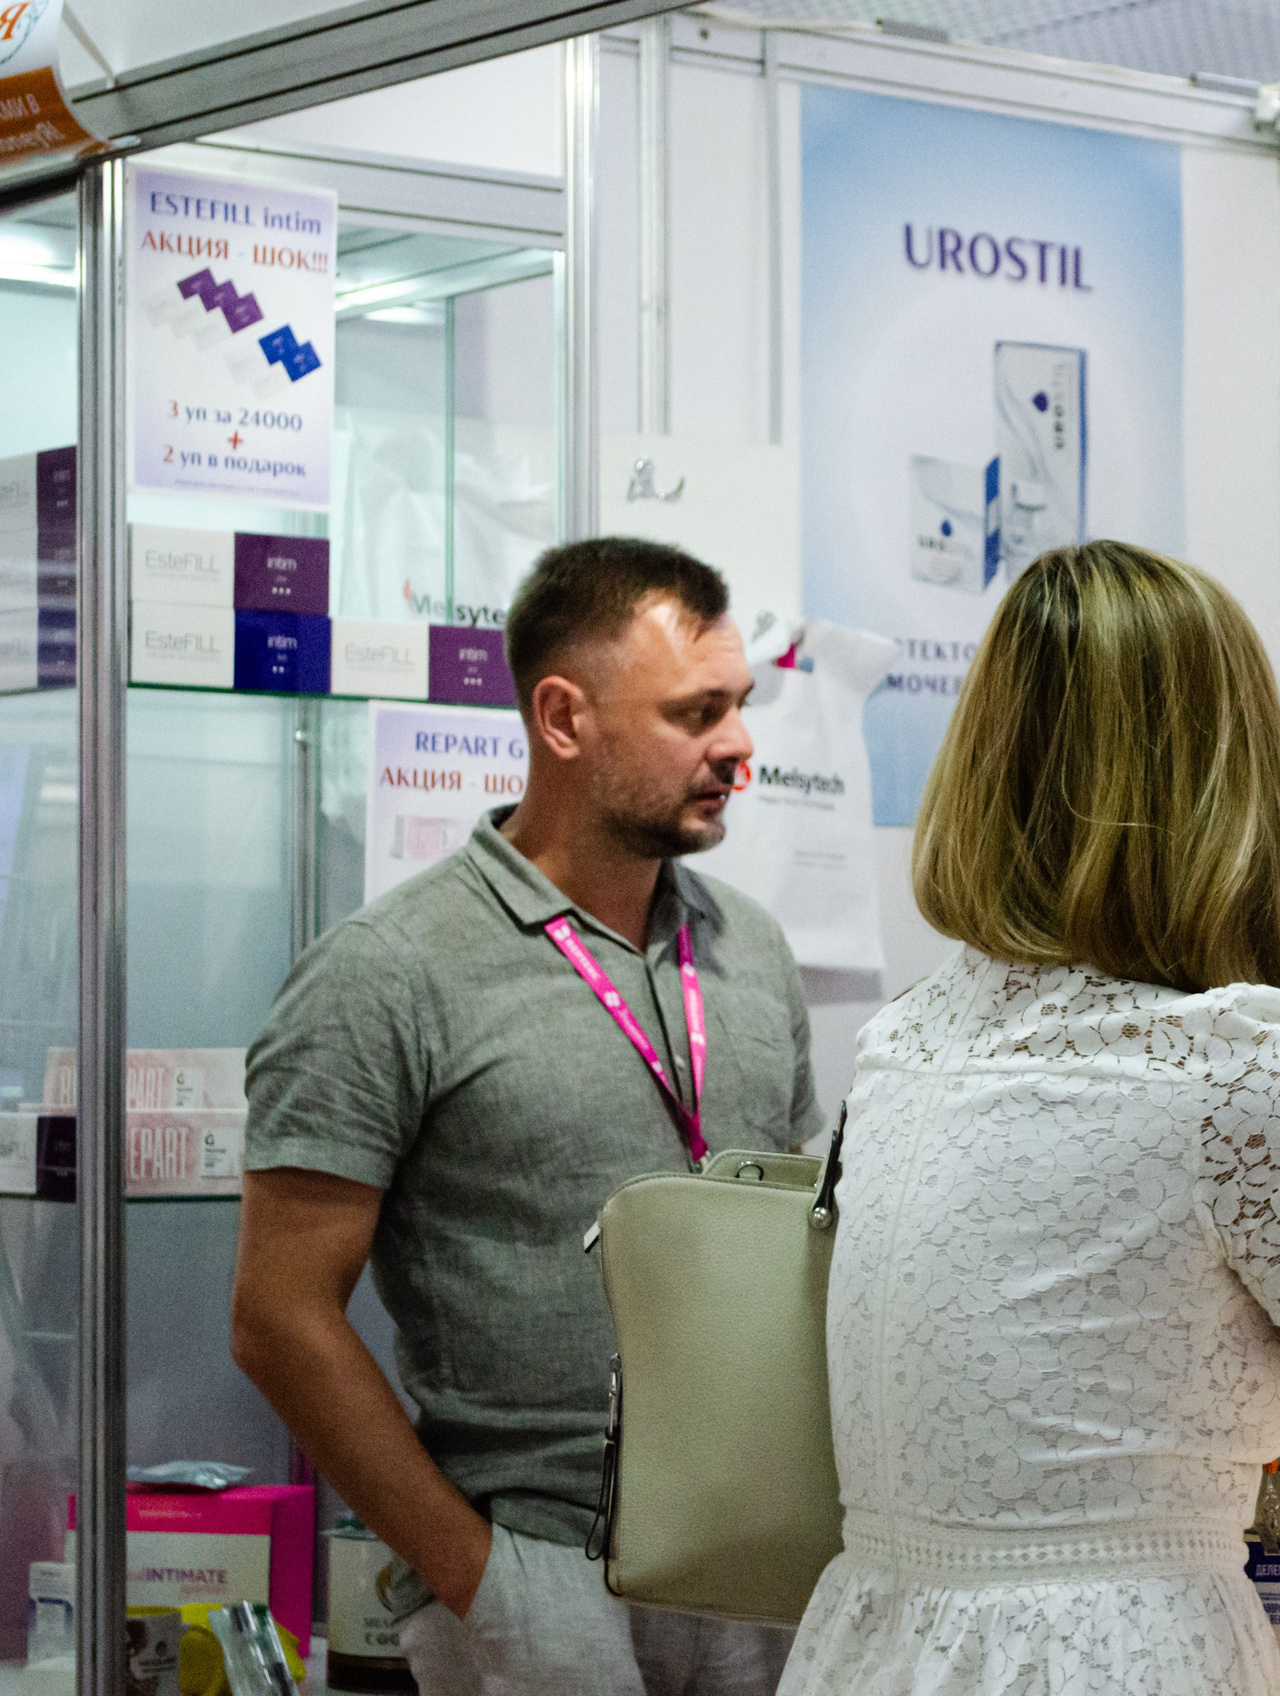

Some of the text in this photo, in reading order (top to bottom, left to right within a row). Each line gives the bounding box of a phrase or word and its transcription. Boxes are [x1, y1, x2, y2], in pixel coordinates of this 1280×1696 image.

[151, 191, 321, 235] ESTEFILL intim
[141, 230, 229, 260] АКЦИЯ
[253, 243, 329, 274] ШОК!!!
[903, 221, 1093, 293] UROSTIL
[169, 399, 303, 431] 3 уп за 24000
[163, 444, 307, 478] 2 уп в подарок
[415, 731, 502, 758] REPART
[379, 766, 462, 793] АКЦИЯ
[758, 764, 845, 796] Melsytech
